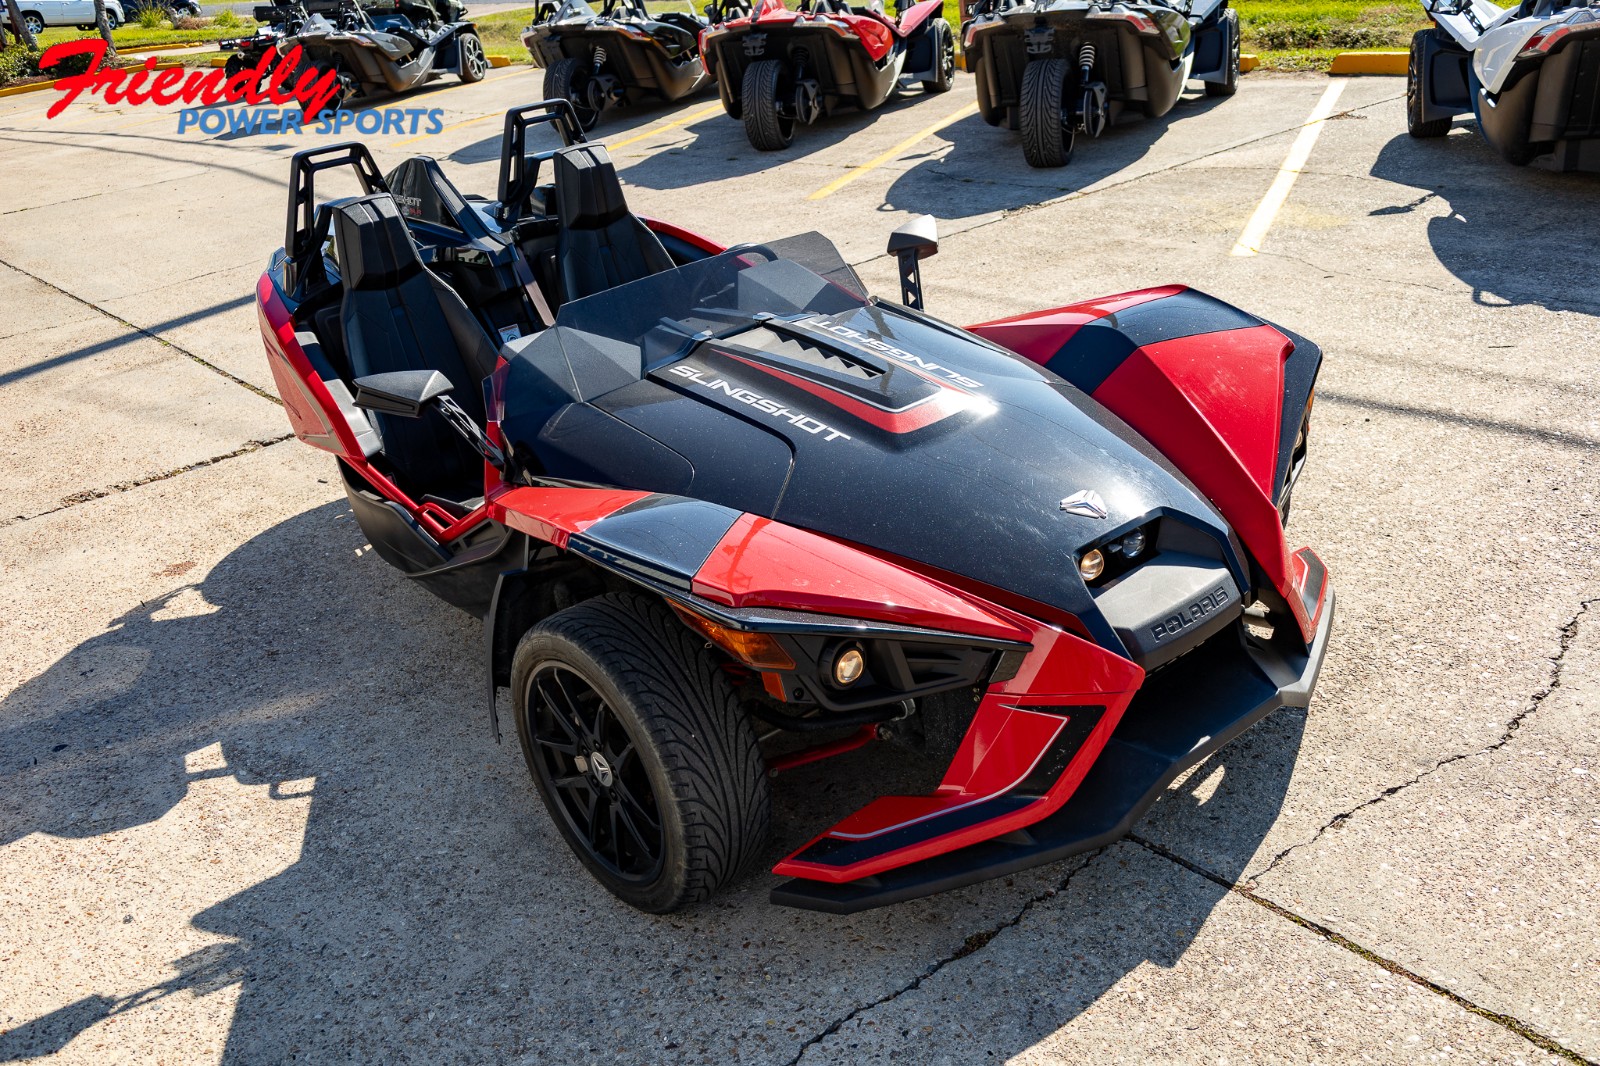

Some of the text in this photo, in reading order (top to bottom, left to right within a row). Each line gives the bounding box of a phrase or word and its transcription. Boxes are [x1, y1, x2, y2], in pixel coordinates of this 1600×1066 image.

[808, 320, 985, 389] SLINGSHOT
[668, 364, 852, 443] SLINGSHOT
[1150, 586, 1229, 643] POLARIS
